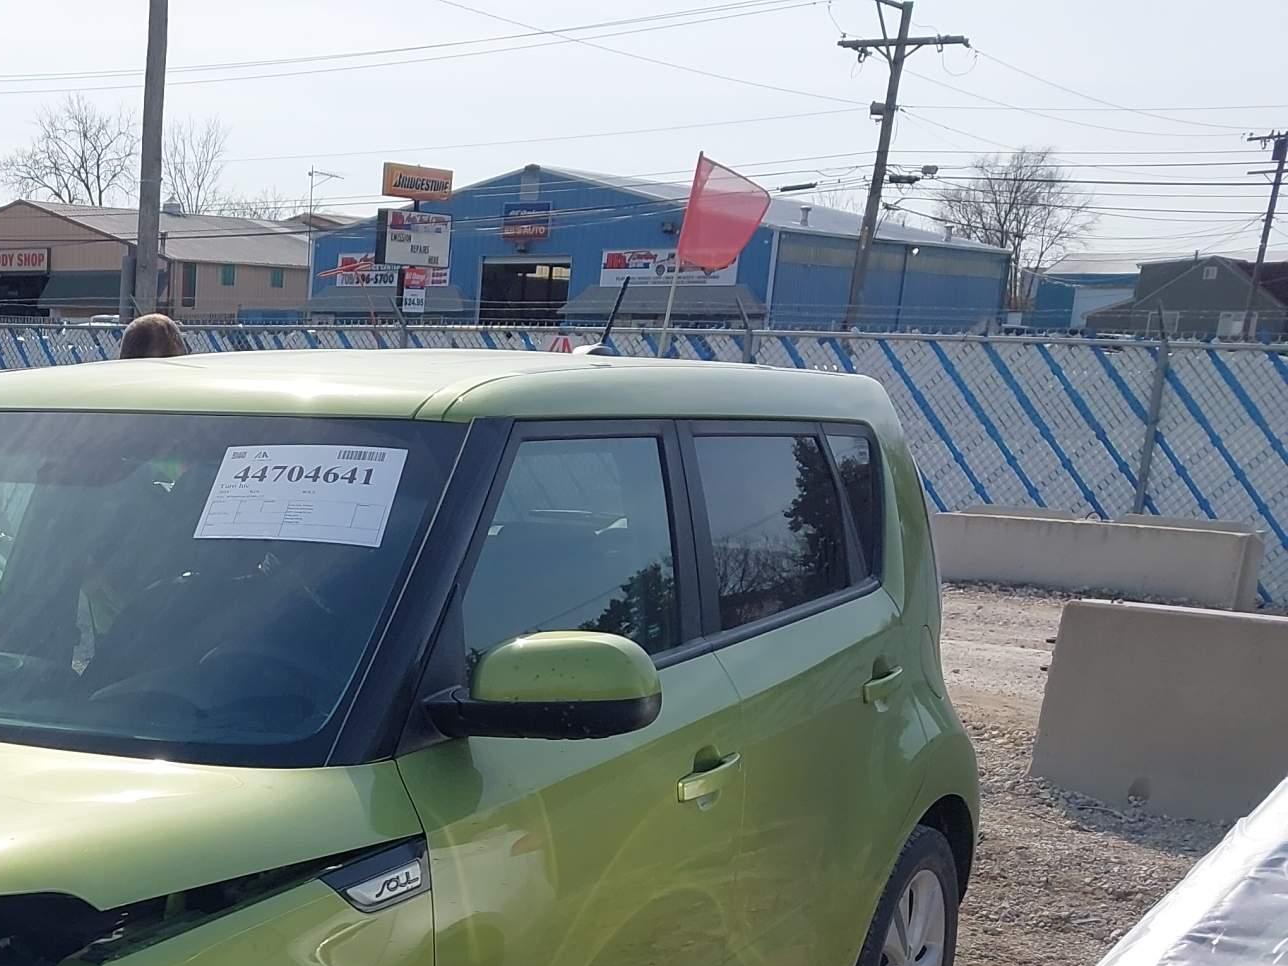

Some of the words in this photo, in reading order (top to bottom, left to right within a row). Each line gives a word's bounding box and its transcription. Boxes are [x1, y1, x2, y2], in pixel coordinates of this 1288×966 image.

[392, 173, 449, 193] BRIDGESTONE
[17, 253, 45, 267] SHOP
[233, 465, 375, 485] 44704641
